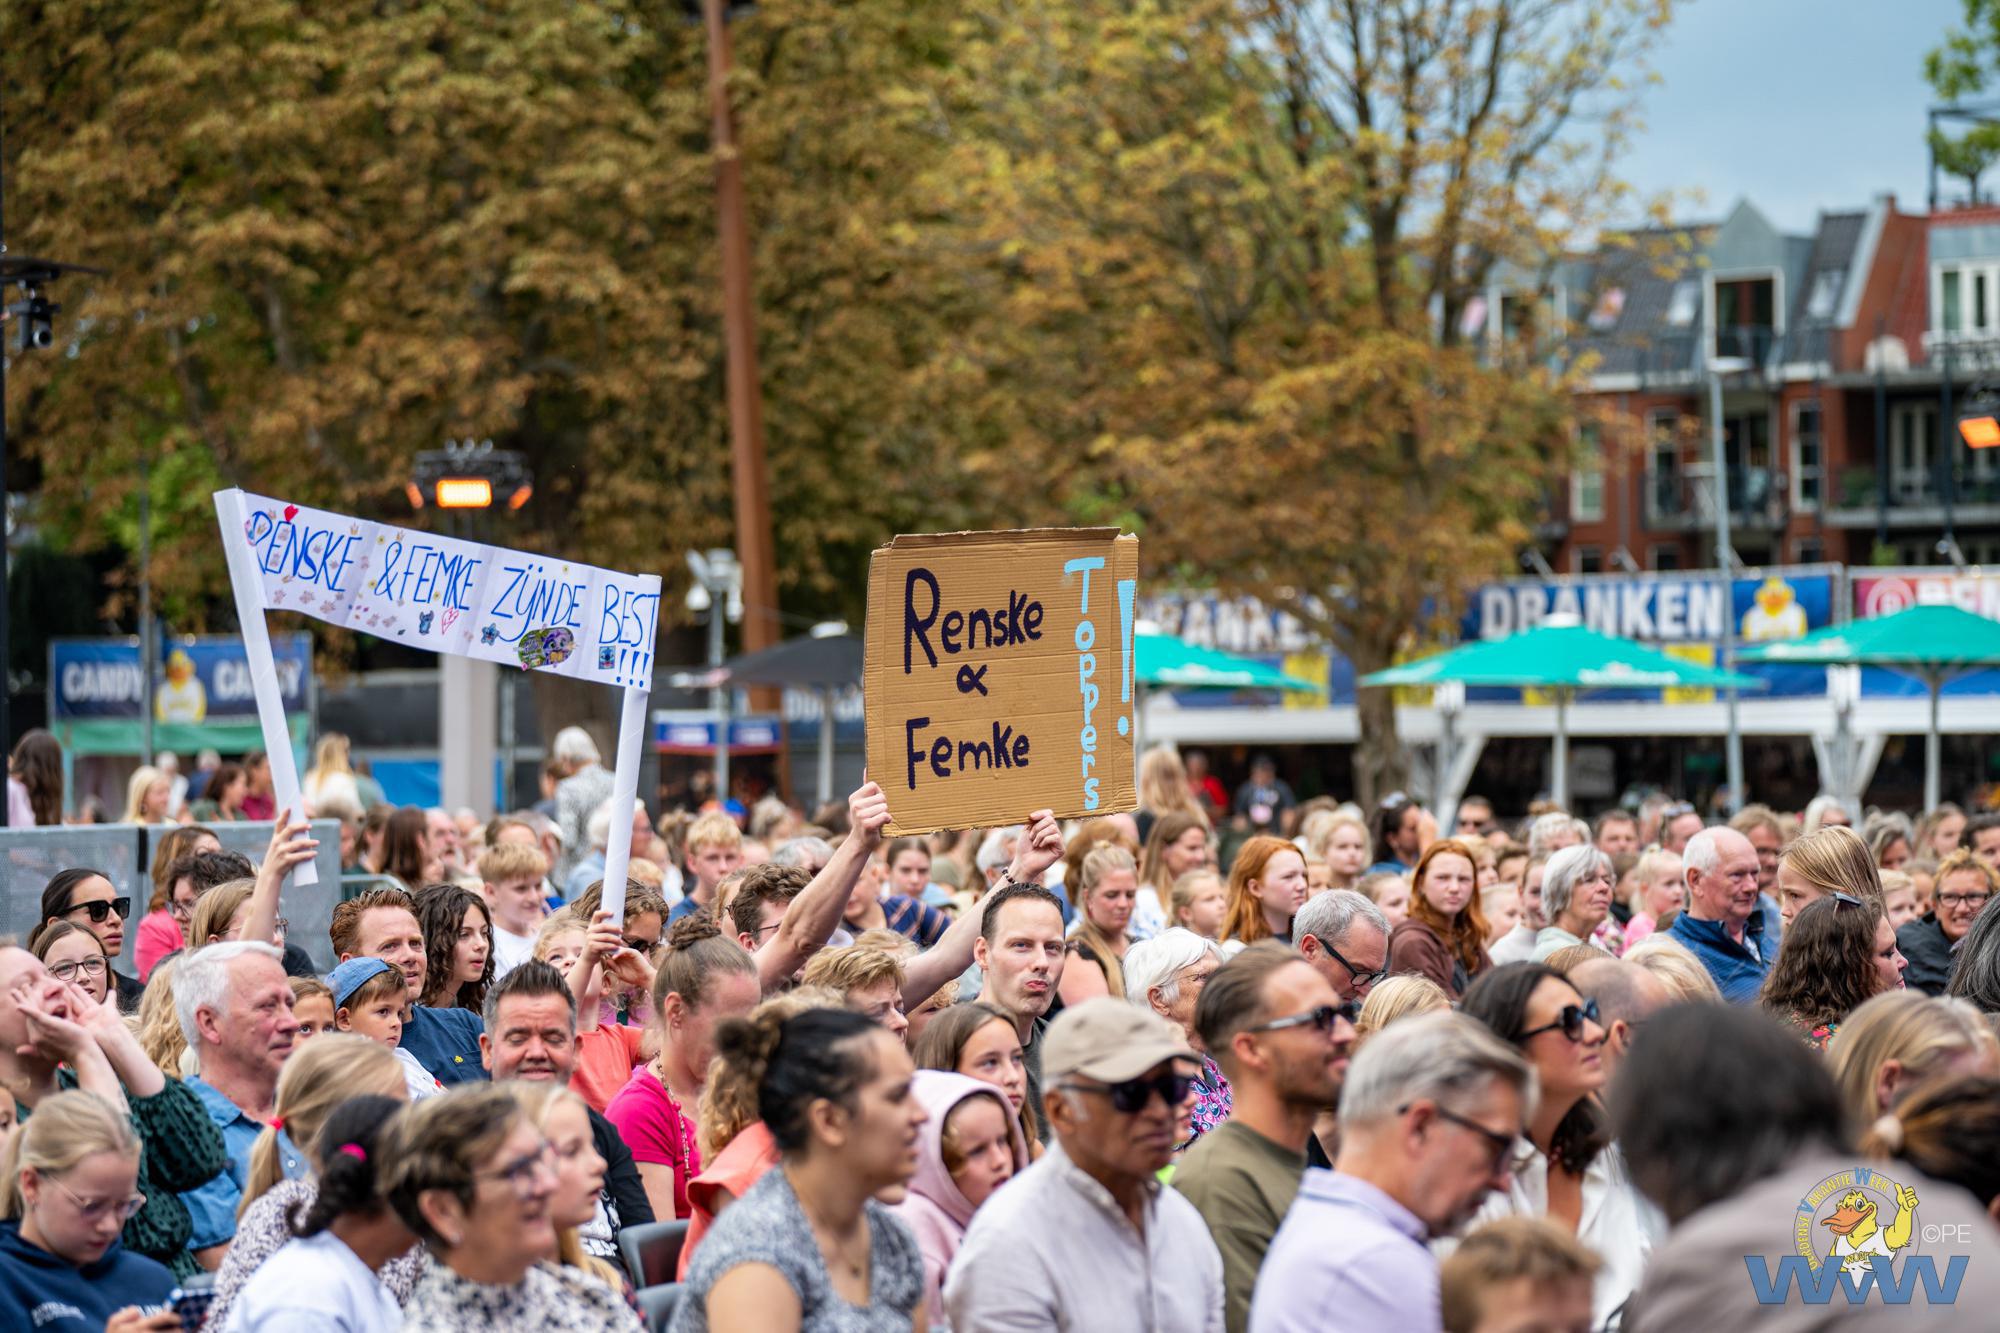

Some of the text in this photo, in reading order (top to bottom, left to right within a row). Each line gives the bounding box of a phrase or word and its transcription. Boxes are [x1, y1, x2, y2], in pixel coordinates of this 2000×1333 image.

[252, 510, 363, 592] RENSKE
[599, 584, 660, 651] BEST
[1480, 582, 1723, 641] DRANKEN
[904, 567, 1043, 674] Renske
[62, 658, 145, 702] CANDY
[616, 649, 650, 688] !!!
[1063, 556, 1105, 811] Toppers
[906, 716, 1030, 791] Femke
